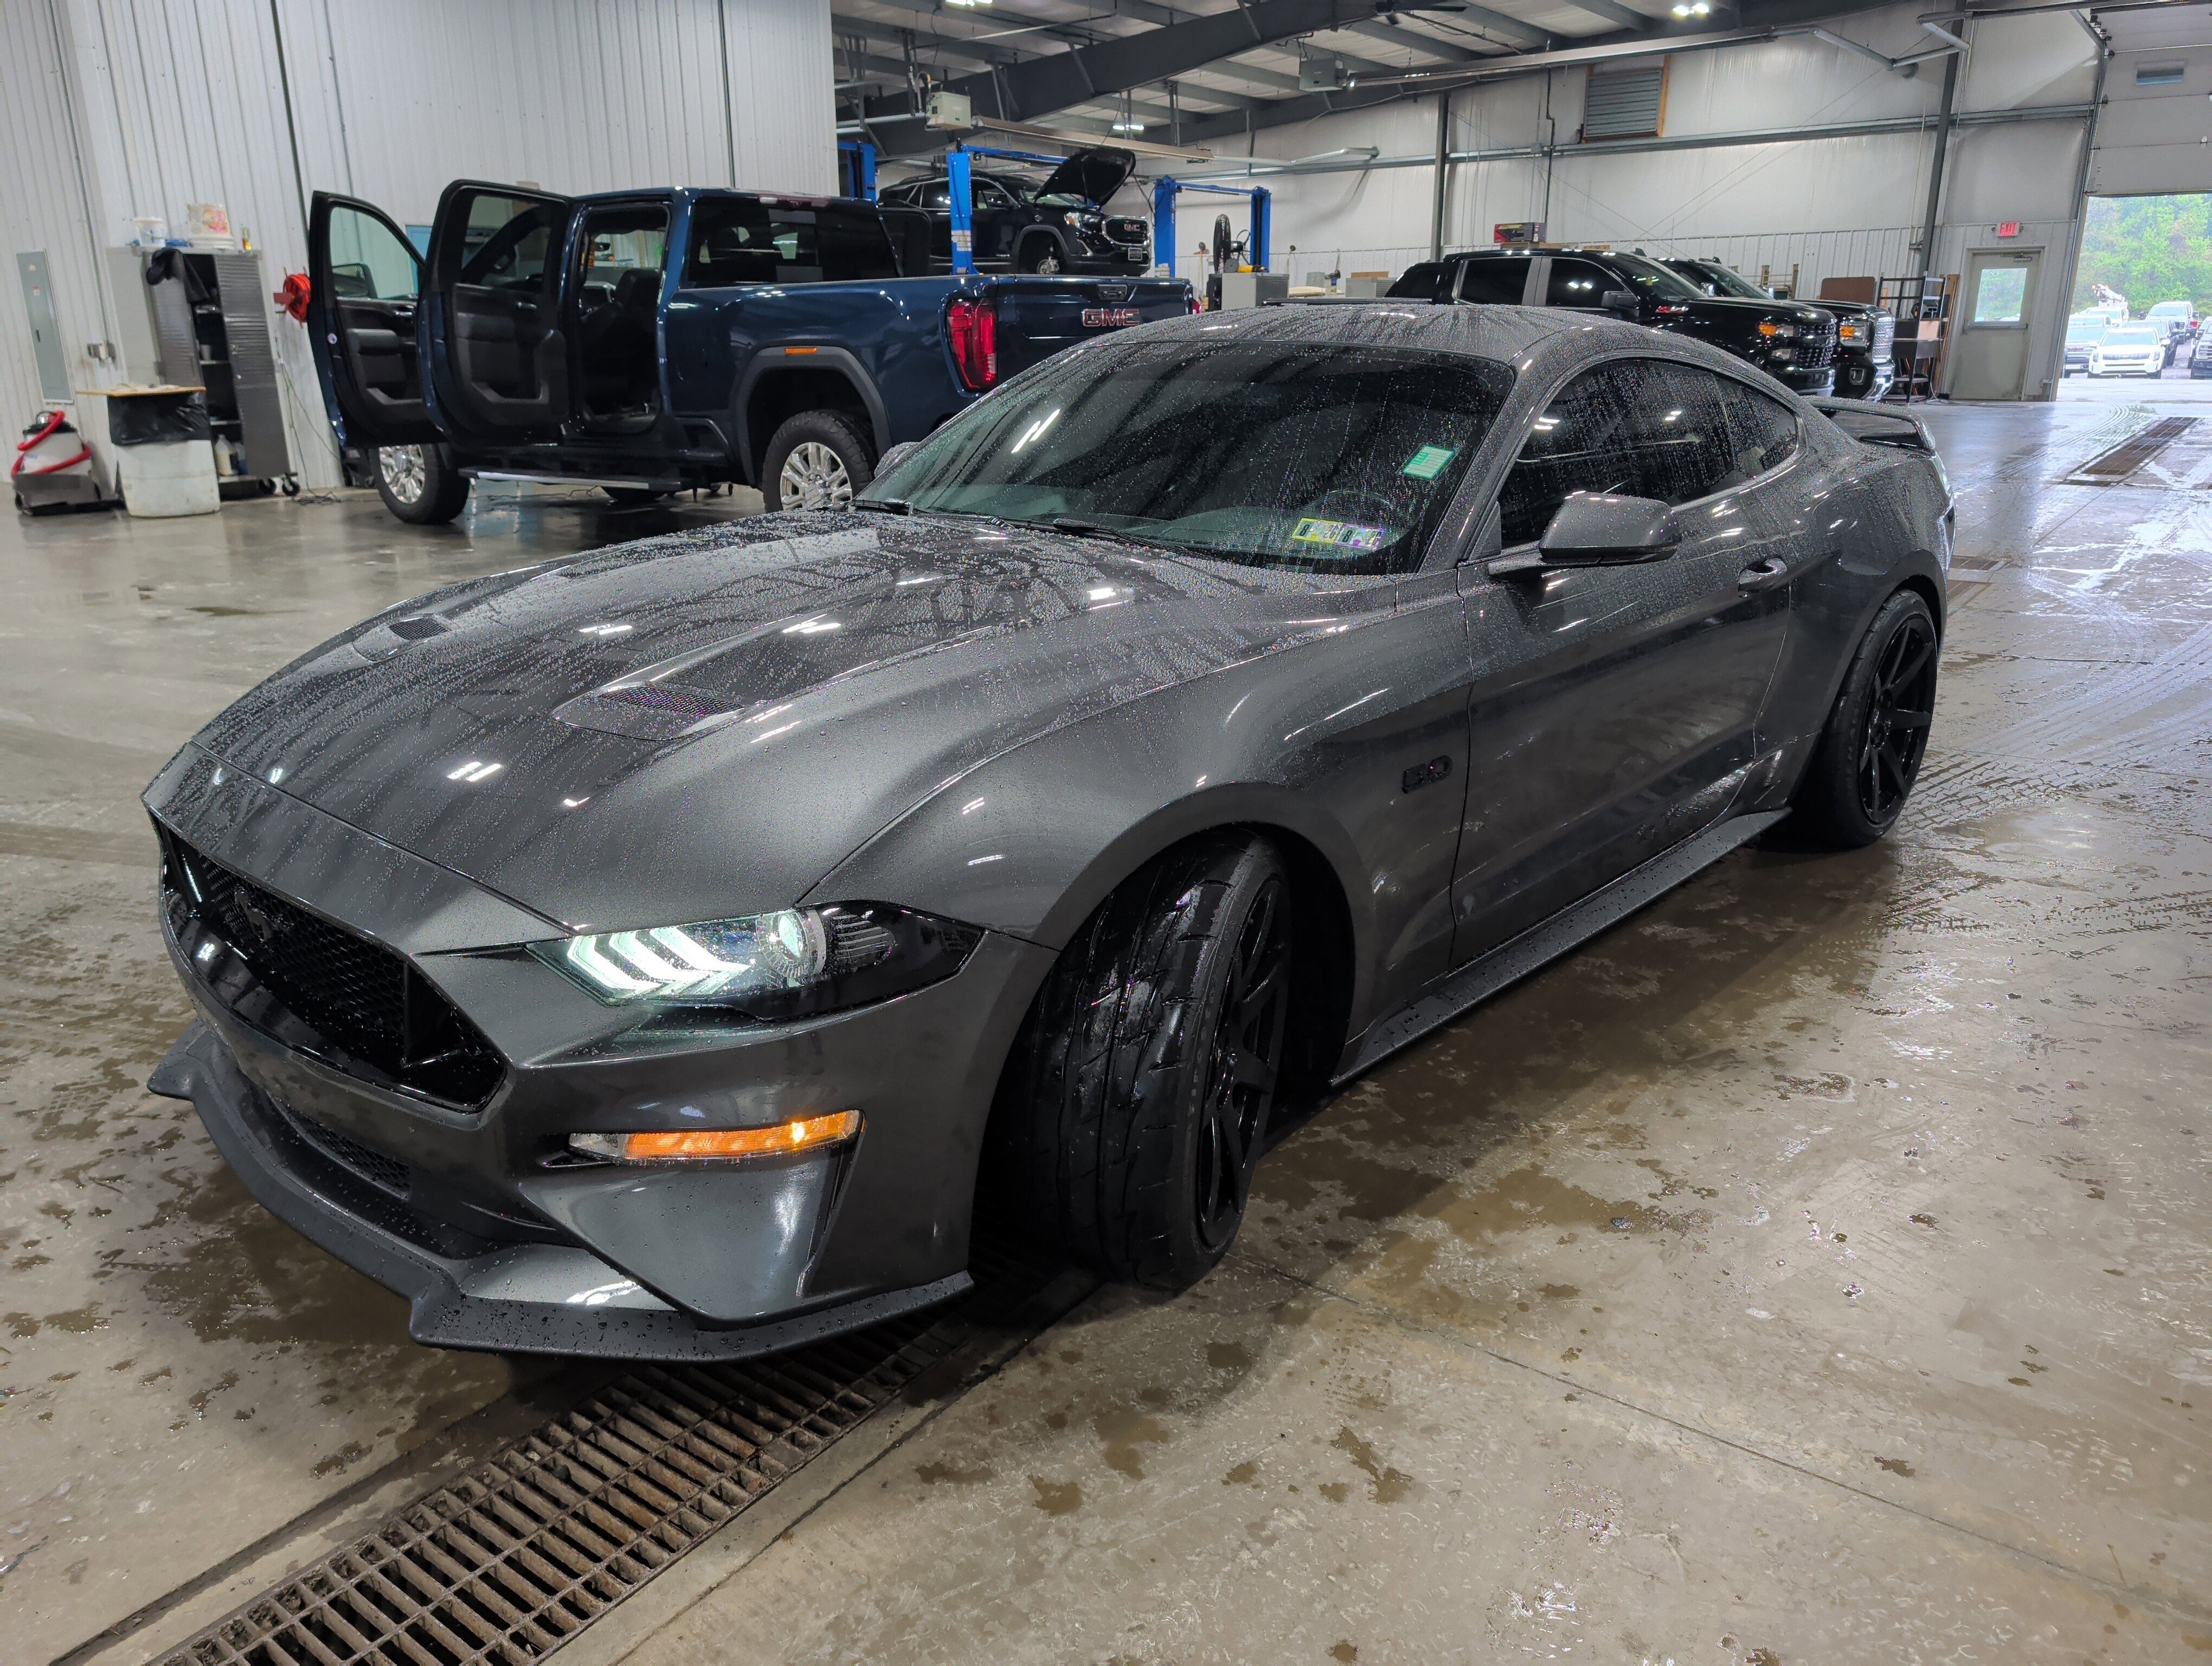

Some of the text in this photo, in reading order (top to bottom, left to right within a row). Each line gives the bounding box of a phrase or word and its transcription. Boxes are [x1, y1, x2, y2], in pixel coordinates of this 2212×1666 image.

[1999, 222, 2017, 235] EXIT
[1081, 307, 1139, 326] GMC
[1298, 524, 1310, 536] 8
[1342, 530, 1353, 542] 8
